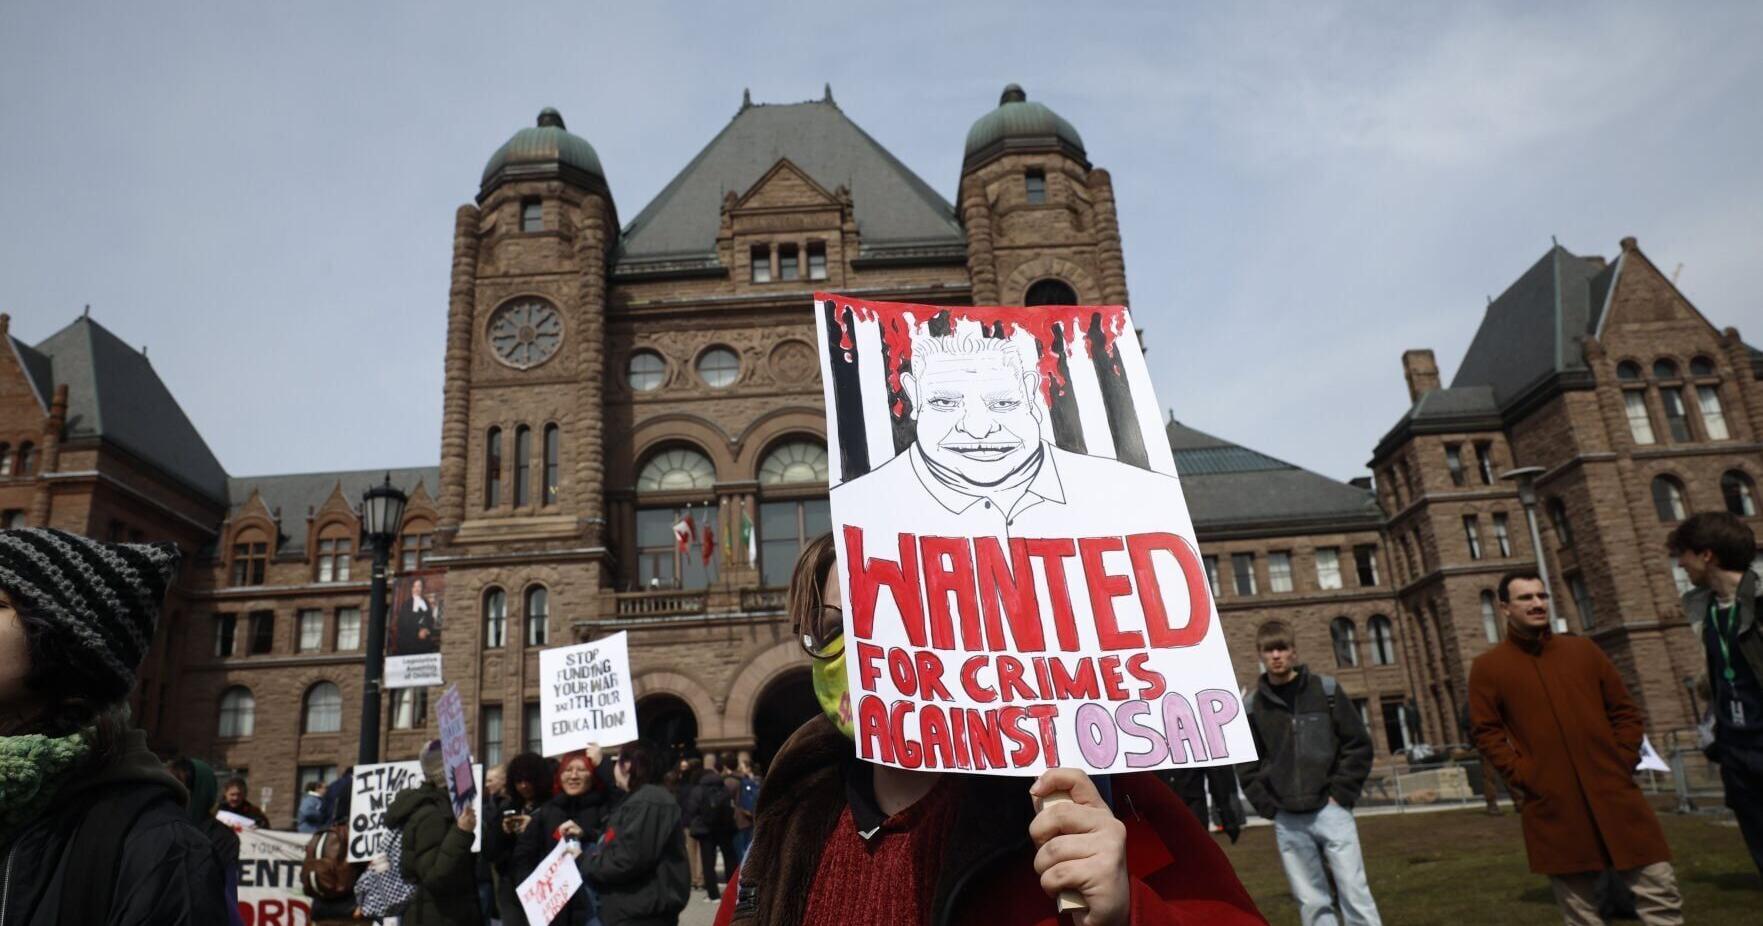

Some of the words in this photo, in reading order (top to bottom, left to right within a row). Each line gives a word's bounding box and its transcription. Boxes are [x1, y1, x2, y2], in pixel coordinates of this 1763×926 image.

[843, 524, 1211, 652] WANTED
[566, 648, 599, 666] STOP
[557, 659, 612, 682] FUNDING
[857, 641, 955, 702] FOR
[960, 652, 1166, 701] CRIMES
[553, 680, 589, 698] YOUR
[590, 673, 618, 694] WAR
[598, 690, 621, 707] OUR
[858, 694, 1061, 770] AGAINST
[1075, 689, 1240, 769] OSAP
[357, 768, 385, 794] IT
